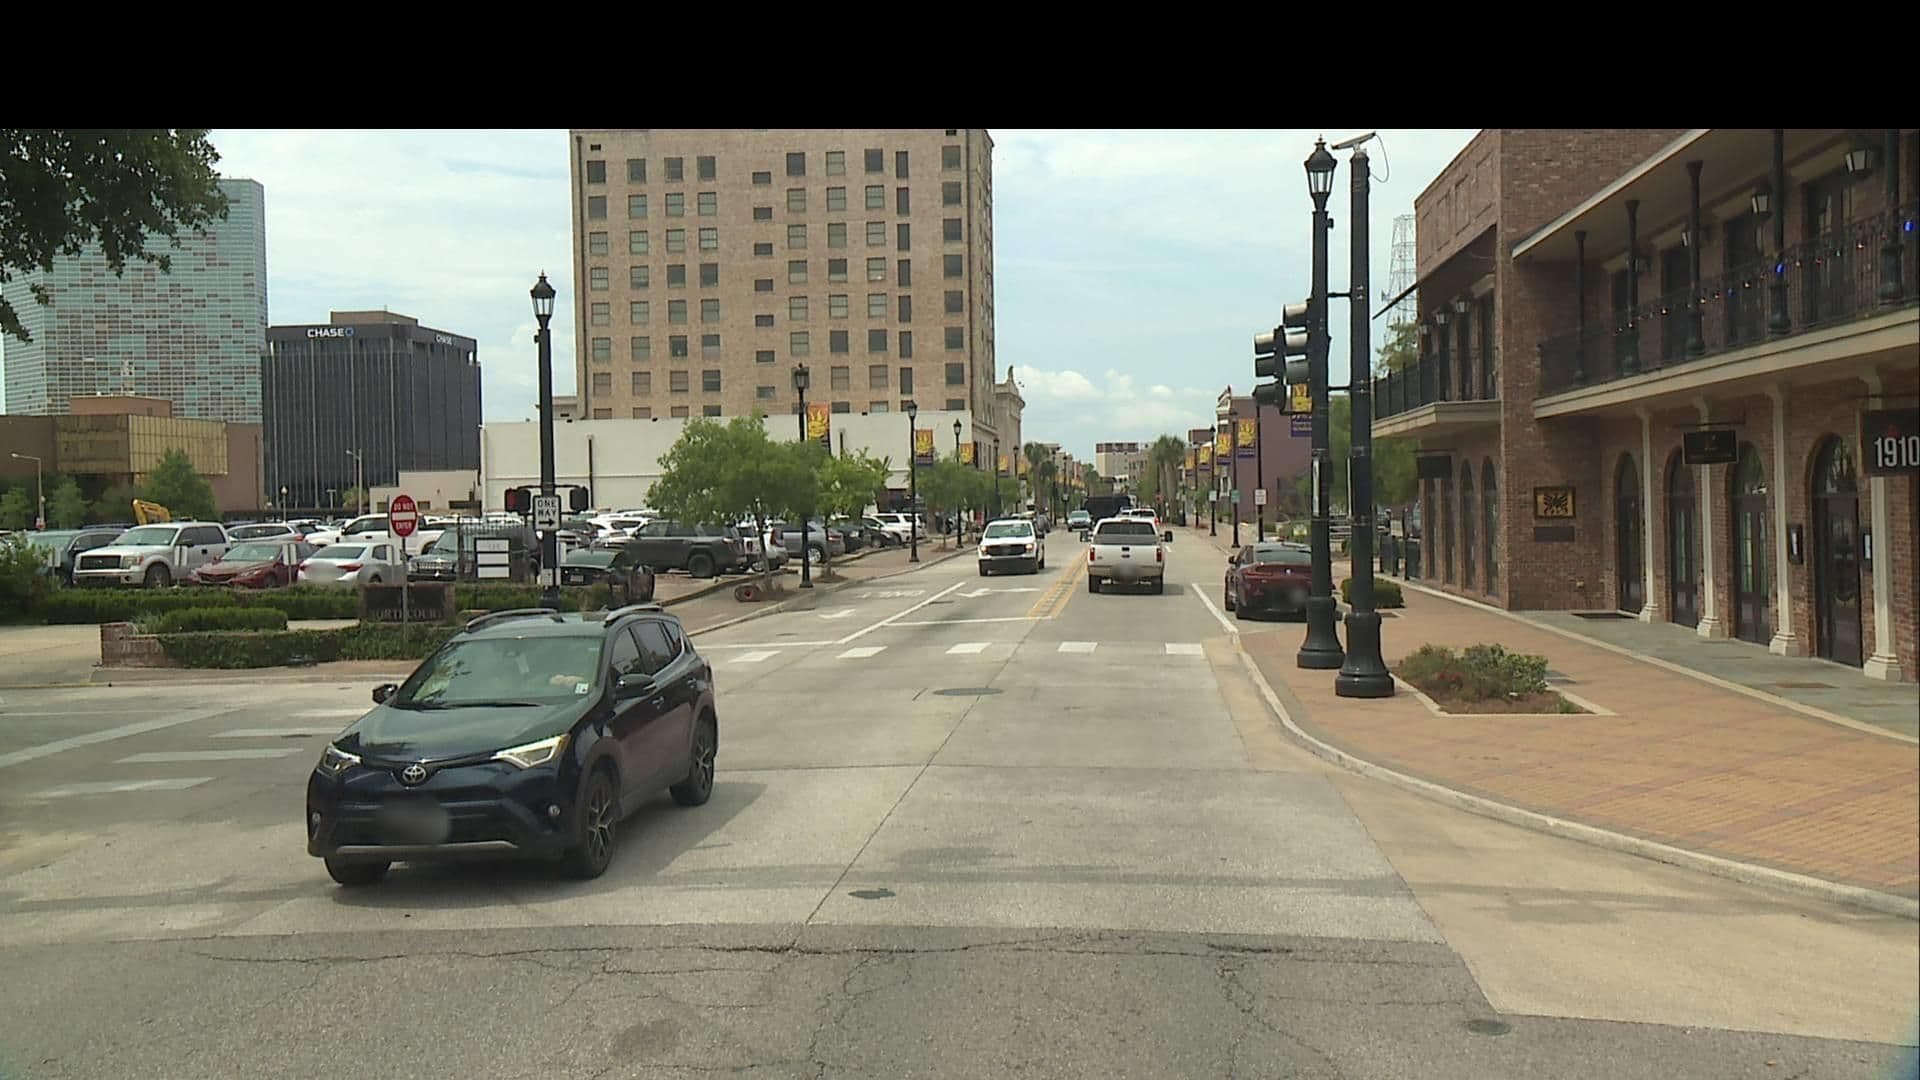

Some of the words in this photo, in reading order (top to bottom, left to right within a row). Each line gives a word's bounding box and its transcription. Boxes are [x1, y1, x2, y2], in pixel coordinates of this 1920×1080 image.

[307, 328, 345, 338] CHASE
[1873, 436, 1919, 468] 1910
[394, 502, 402, 511] DO
[402, 502, 414, 511] NOT
[537, 500, 557, 508] ONE
[538, 509, 557, 517] WAY
[395, 521, 412, 530] ENTER
